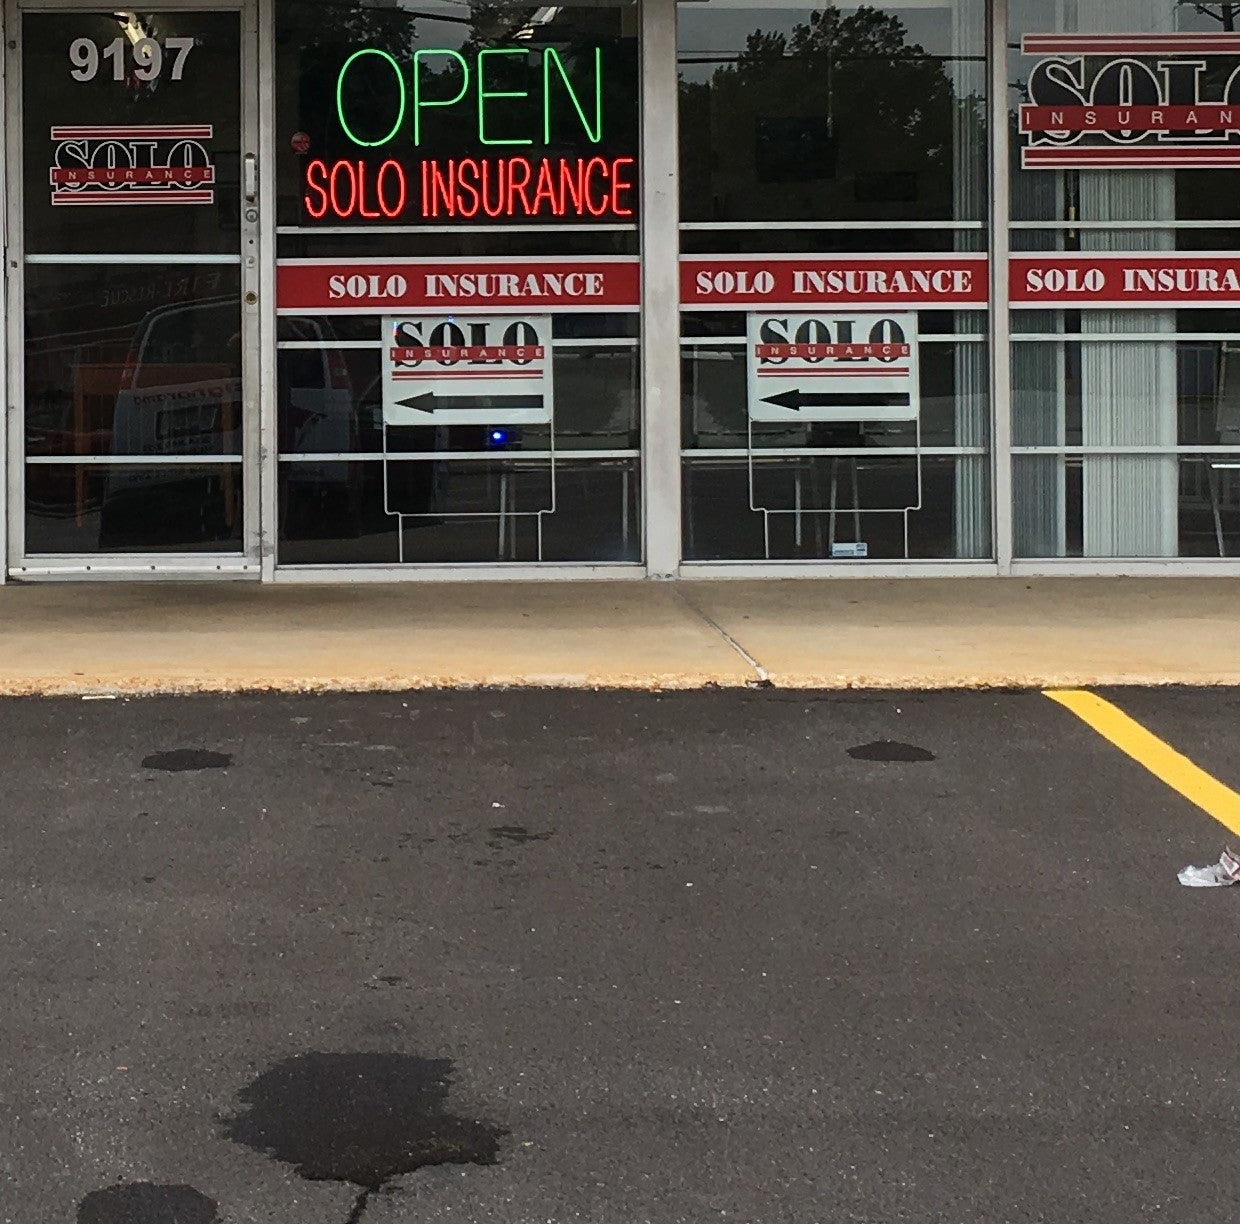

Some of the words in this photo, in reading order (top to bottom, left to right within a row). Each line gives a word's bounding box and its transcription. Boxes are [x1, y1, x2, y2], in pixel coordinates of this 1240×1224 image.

[69, 37, 194, 82] 9197
[336, 47, 603, 147] OPEN
[1027, 57, 1240, 146] SOL
[1025, 111, 1233, 125] INSURAN
[53, 170, 211, 180] INSURANCE
[55, 140, 210, 193] SOLO
[304, 159, 406, 218] SOLO
[421, 157, 634, 217] INSURANCE
[328, 274, 407, 298] SOLO
[424, 273, 605, 297] INSURANCE
[696, 271, 775, 295] SOLO
[792, 270, 973, 294] INSURANCE
[1026, 268, 1105, 292] SOLO
[1122, 268, 1240, 292] INSURA
[391, 348, 543, 358] INSURANCE
[394, 321, 540, 368] SOLO
[756, 346, 909, 355] INSURANCE
[760, 318, 906, 365] SOLO
